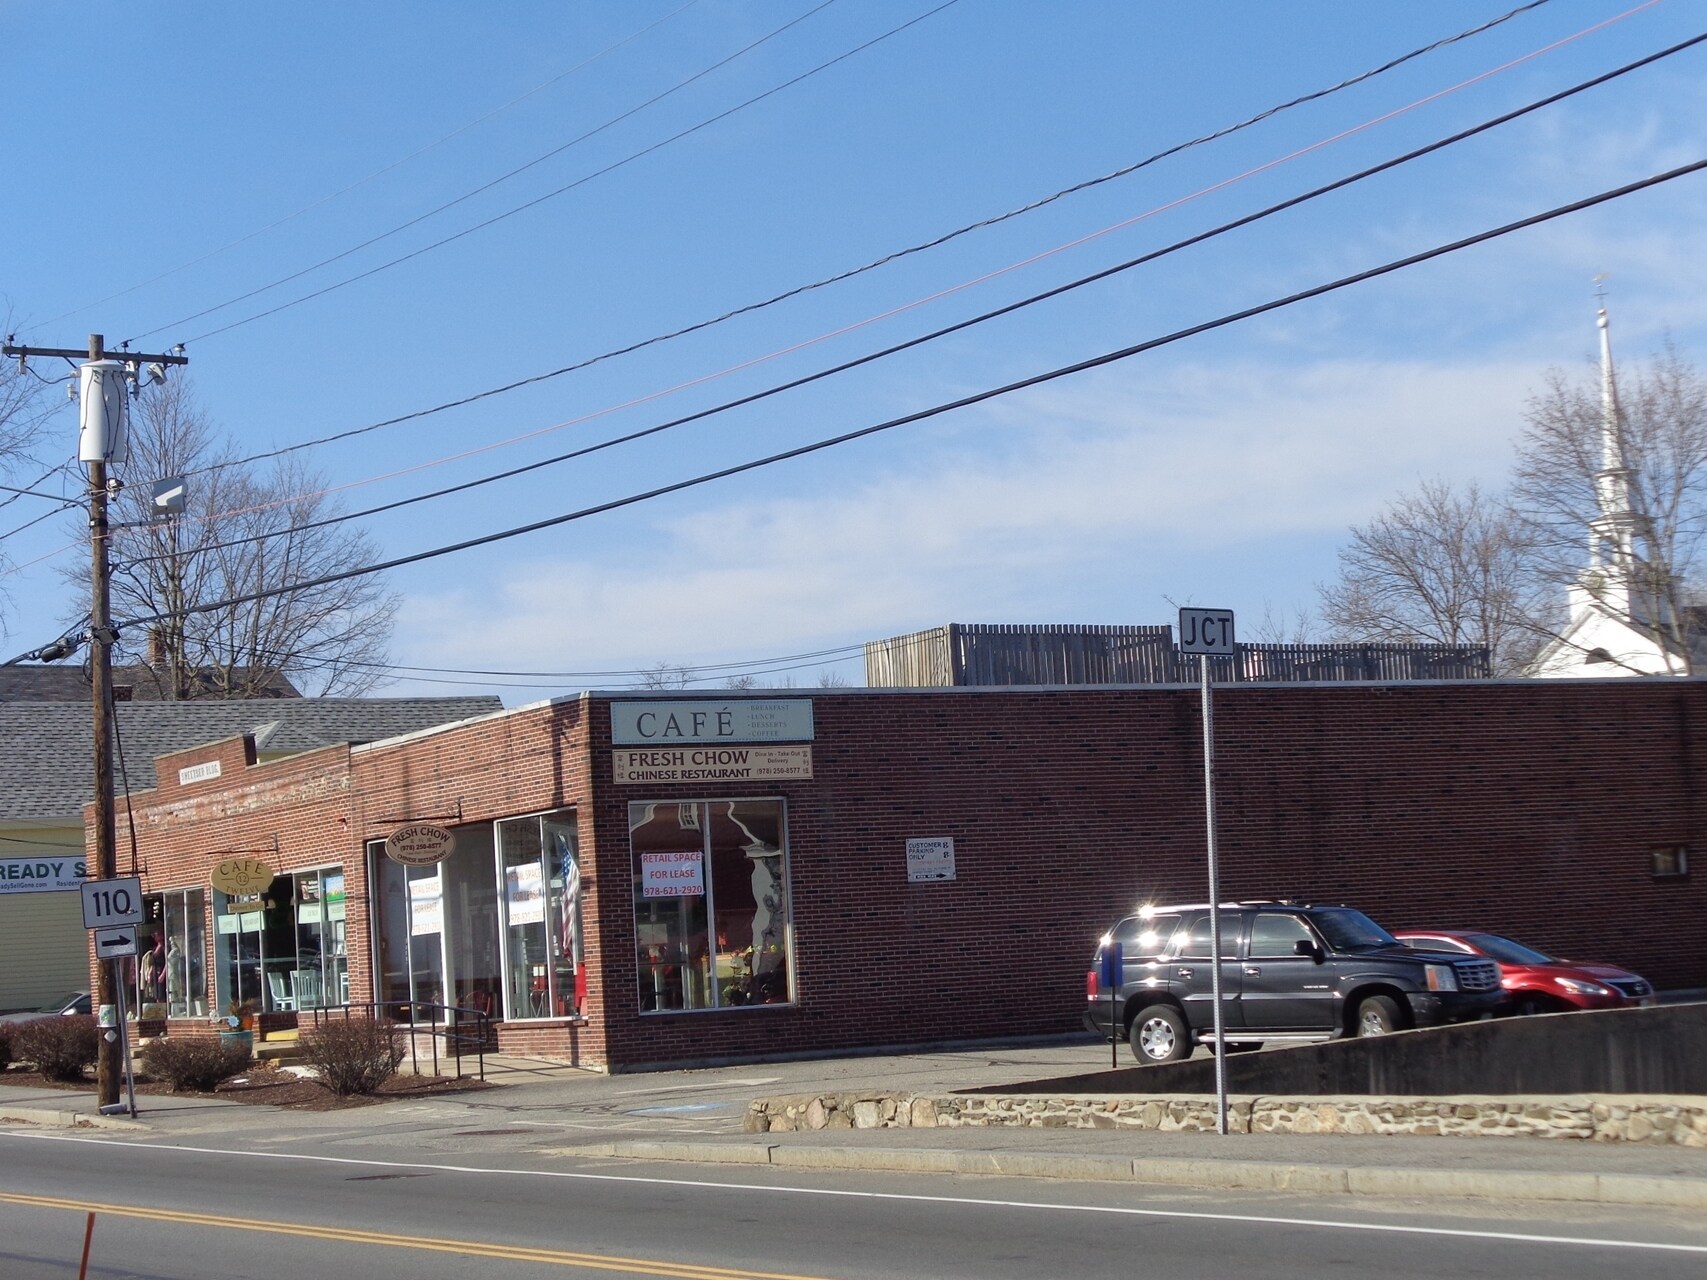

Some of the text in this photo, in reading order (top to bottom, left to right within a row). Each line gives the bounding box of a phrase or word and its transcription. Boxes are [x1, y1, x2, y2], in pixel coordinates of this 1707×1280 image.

[1184, 616, 1230, 647] JCT
[636, 706, 734, 738] CAFÉ
[628, 751, 685, 767] FRESH
[691, 750, 750, 765] CHOW
[628, 768, 751, 780] CHINESE RESTAURANT
[391, 827, 450, 847] FRESH CHOW
[908, 841, 942, 849] CUSTOMER
[643, 853, 701, 863] RETAIL SPACE
[219, 861, 265, 876] CAFE
[650, 869, 695, 879] FOR LEASE
[238, 875, 247, 883] 12
[226, 885, 261, 895] TWELVE
[644, 885, 703, 896] 978-621-2920
[92, 889, 131, 917] 110
